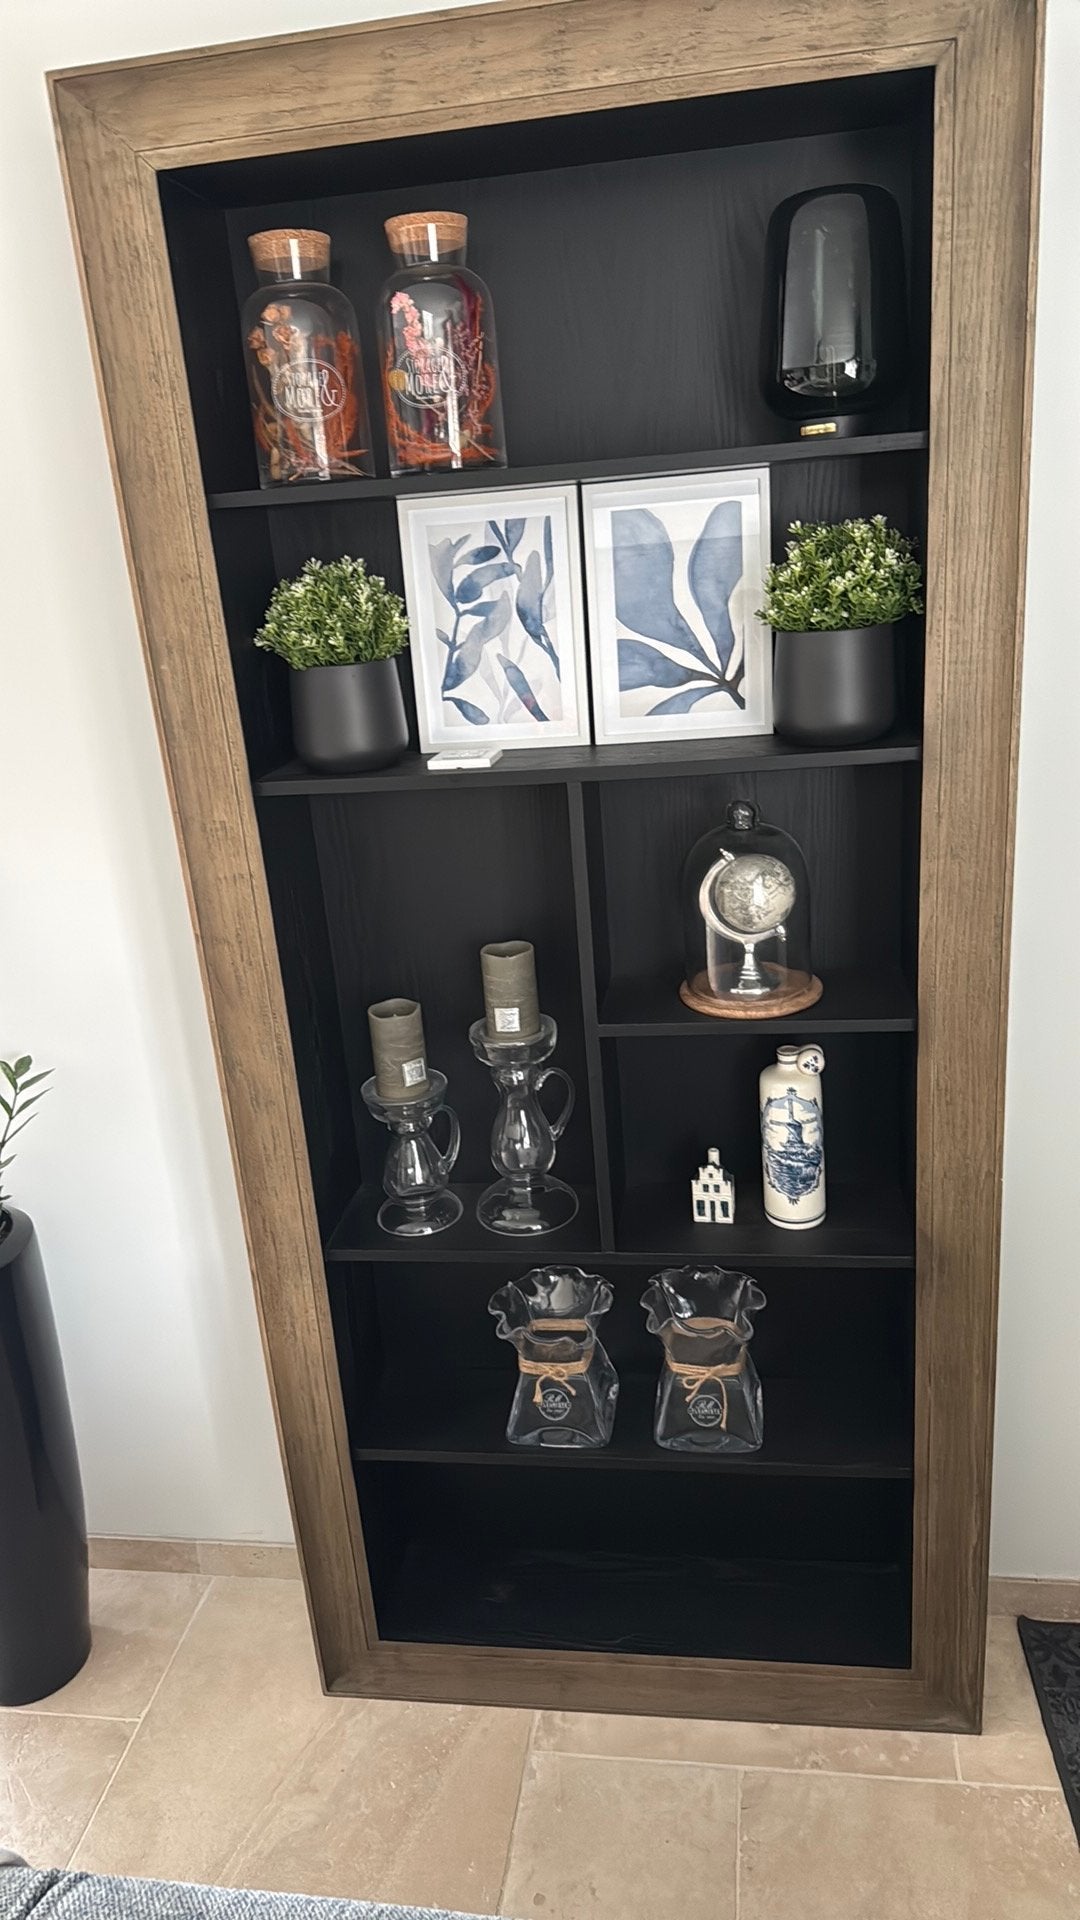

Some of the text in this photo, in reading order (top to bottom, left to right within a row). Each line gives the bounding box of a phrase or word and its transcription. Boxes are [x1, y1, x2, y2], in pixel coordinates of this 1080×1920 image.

[283, 369, 341, 407] STORAE &
[404, 372, 440, 396] MORE
[284, 386, 321, 409] MORE
